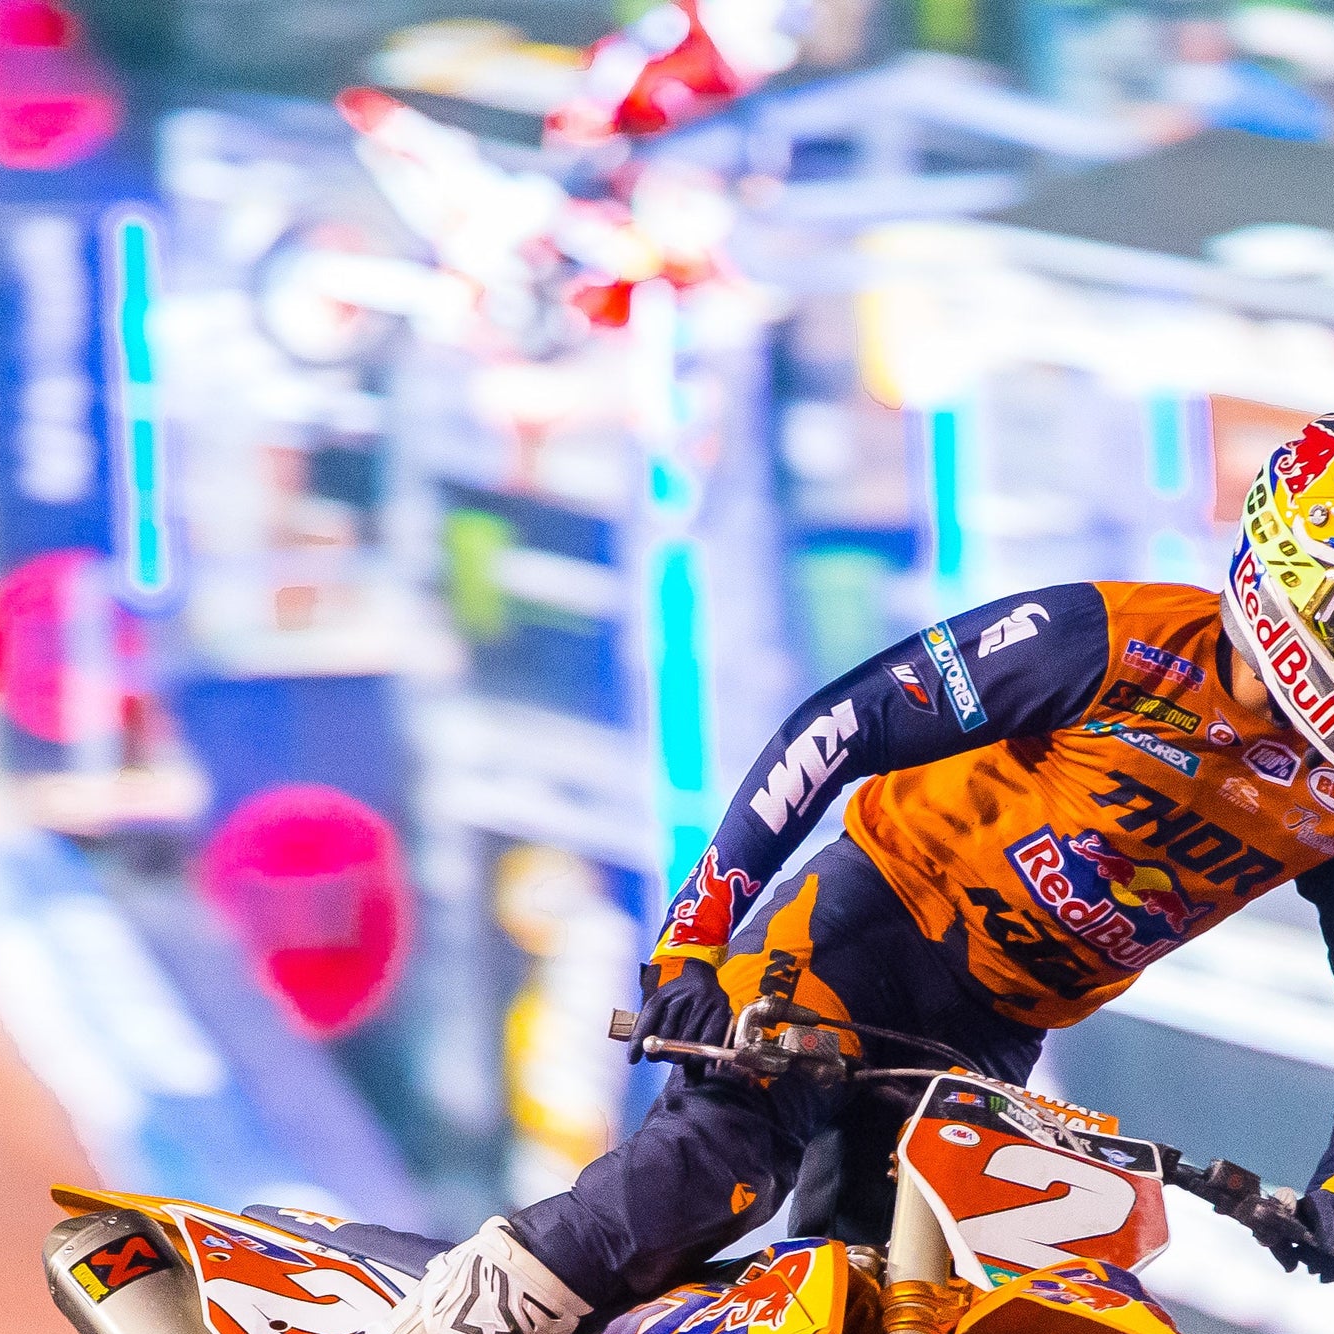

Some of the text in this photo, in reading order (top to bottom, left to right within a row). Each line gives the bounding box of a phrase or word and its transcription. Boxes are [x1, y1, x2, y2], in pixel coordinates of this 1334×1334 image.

[1246, 466, 1314, 588] 00%
[1235, 552, 1289, 648] Red
[933, 640, 977, 720] OTOREX
[749, 698, 860, 835] KTM
[1121, 731, 1192, 771] OTOREX
[1251, 748, 1293, 778] 100%
[1089, 770, 1286, 897] THOR
[1018, 838, 1177, 968] Red Bull
[957, 1143, 1136, 1270] 2
